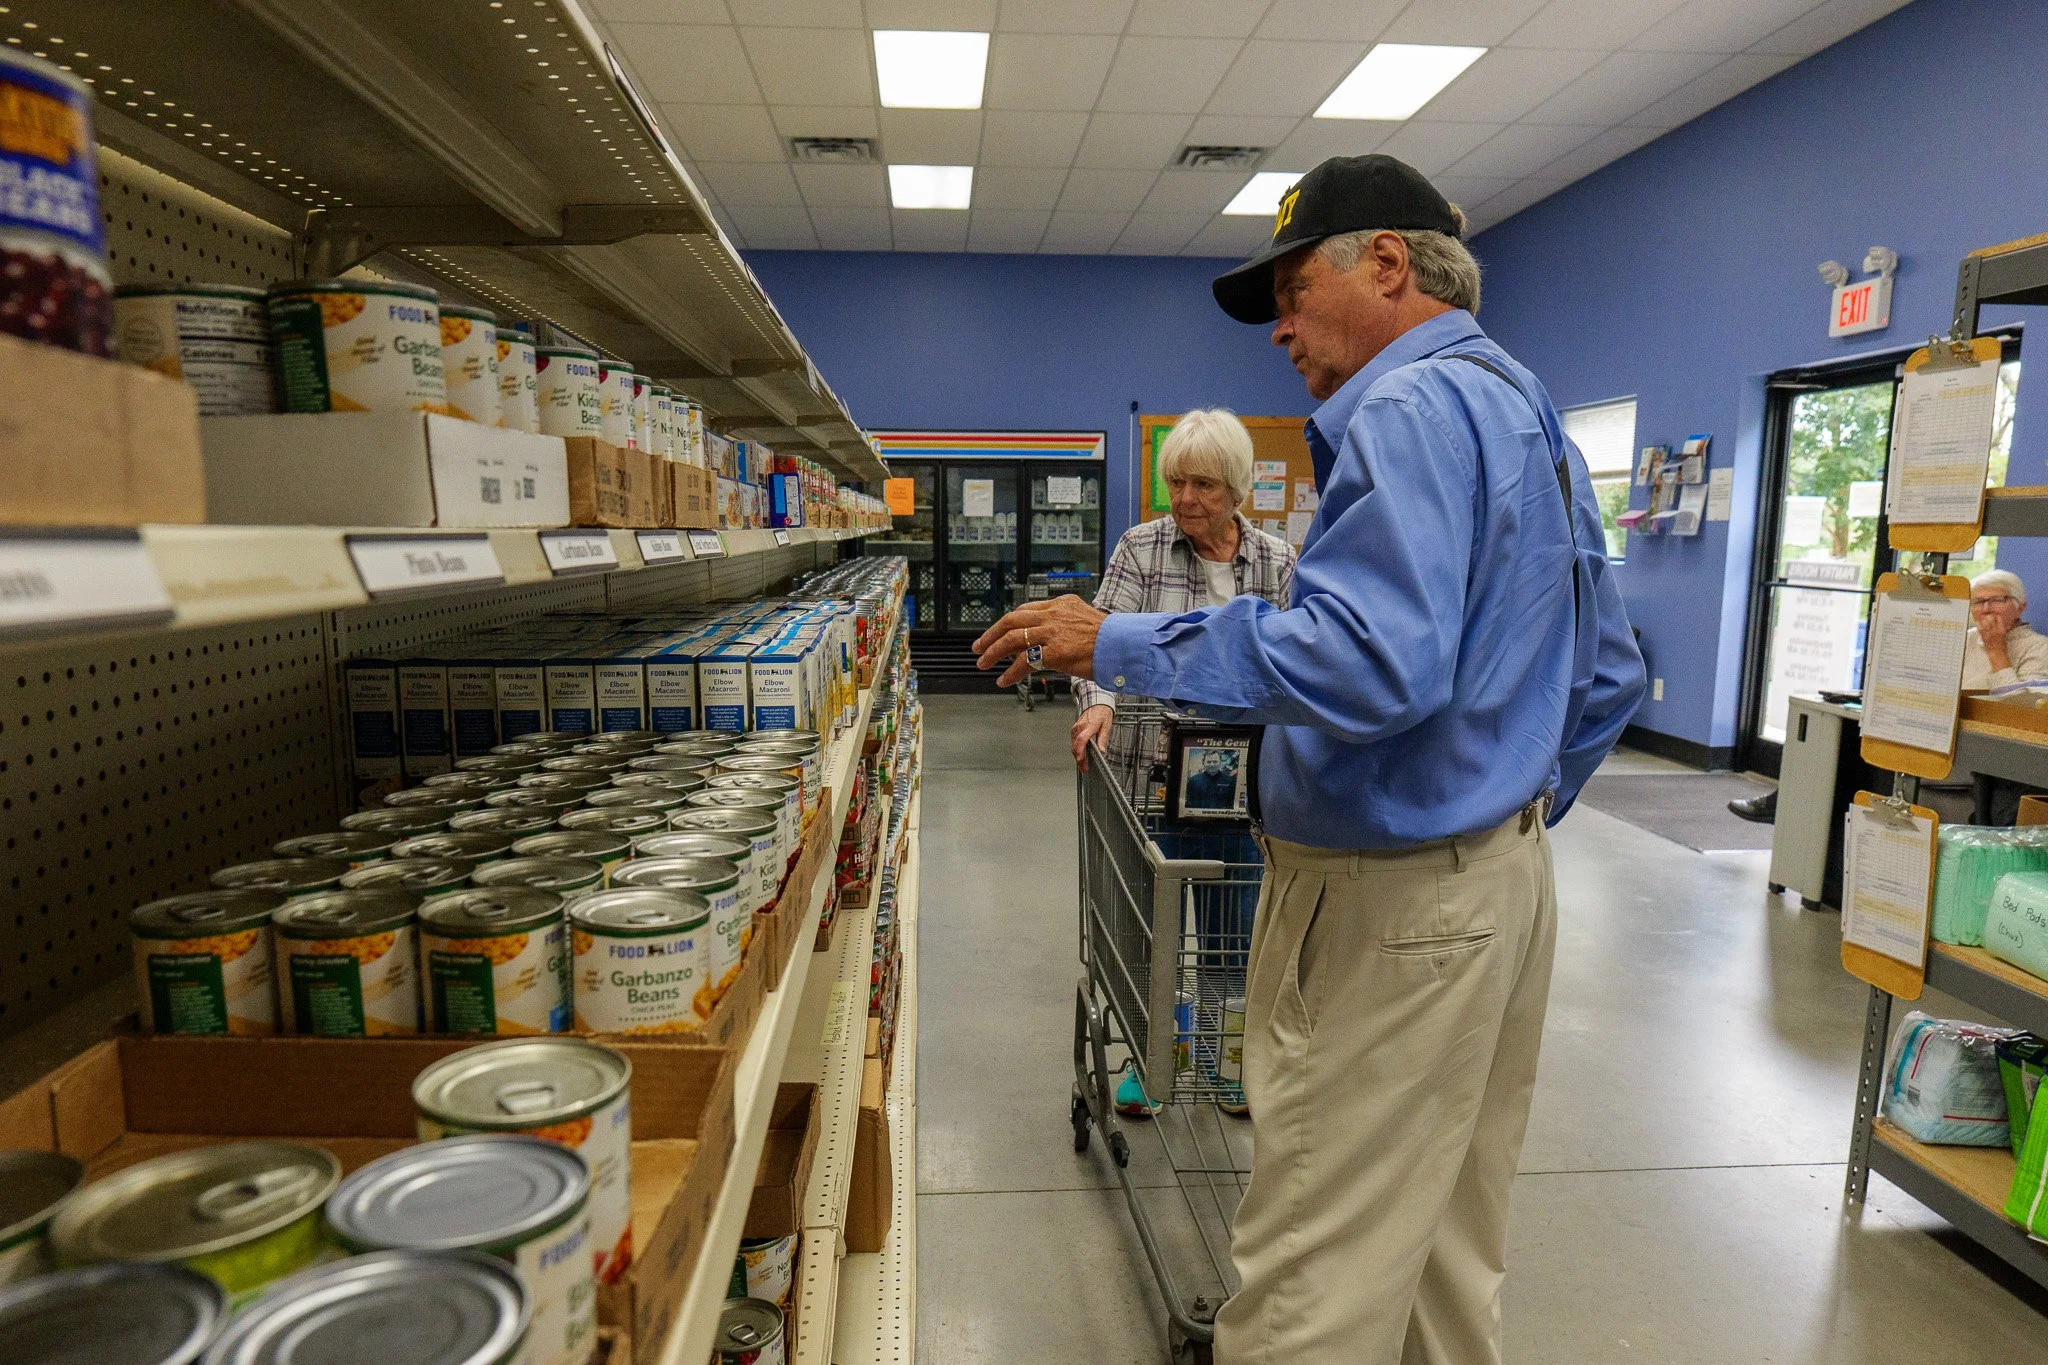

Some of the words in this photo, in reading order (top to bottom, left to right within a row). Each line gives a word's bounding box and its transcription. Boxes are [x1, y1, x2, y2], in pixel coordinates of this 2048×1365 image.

[1839, 286, 1872, 328] EXIT
[713, 678, 734, 686] Elbow
[2002, 895, 2019, 912] Bed
[609, 944, 645, 959] FOOD
[666, 938, 694, 956] LION
[611, 967, 694, 987] Garbanzo
[627, 986, 680, 1004] Beans
